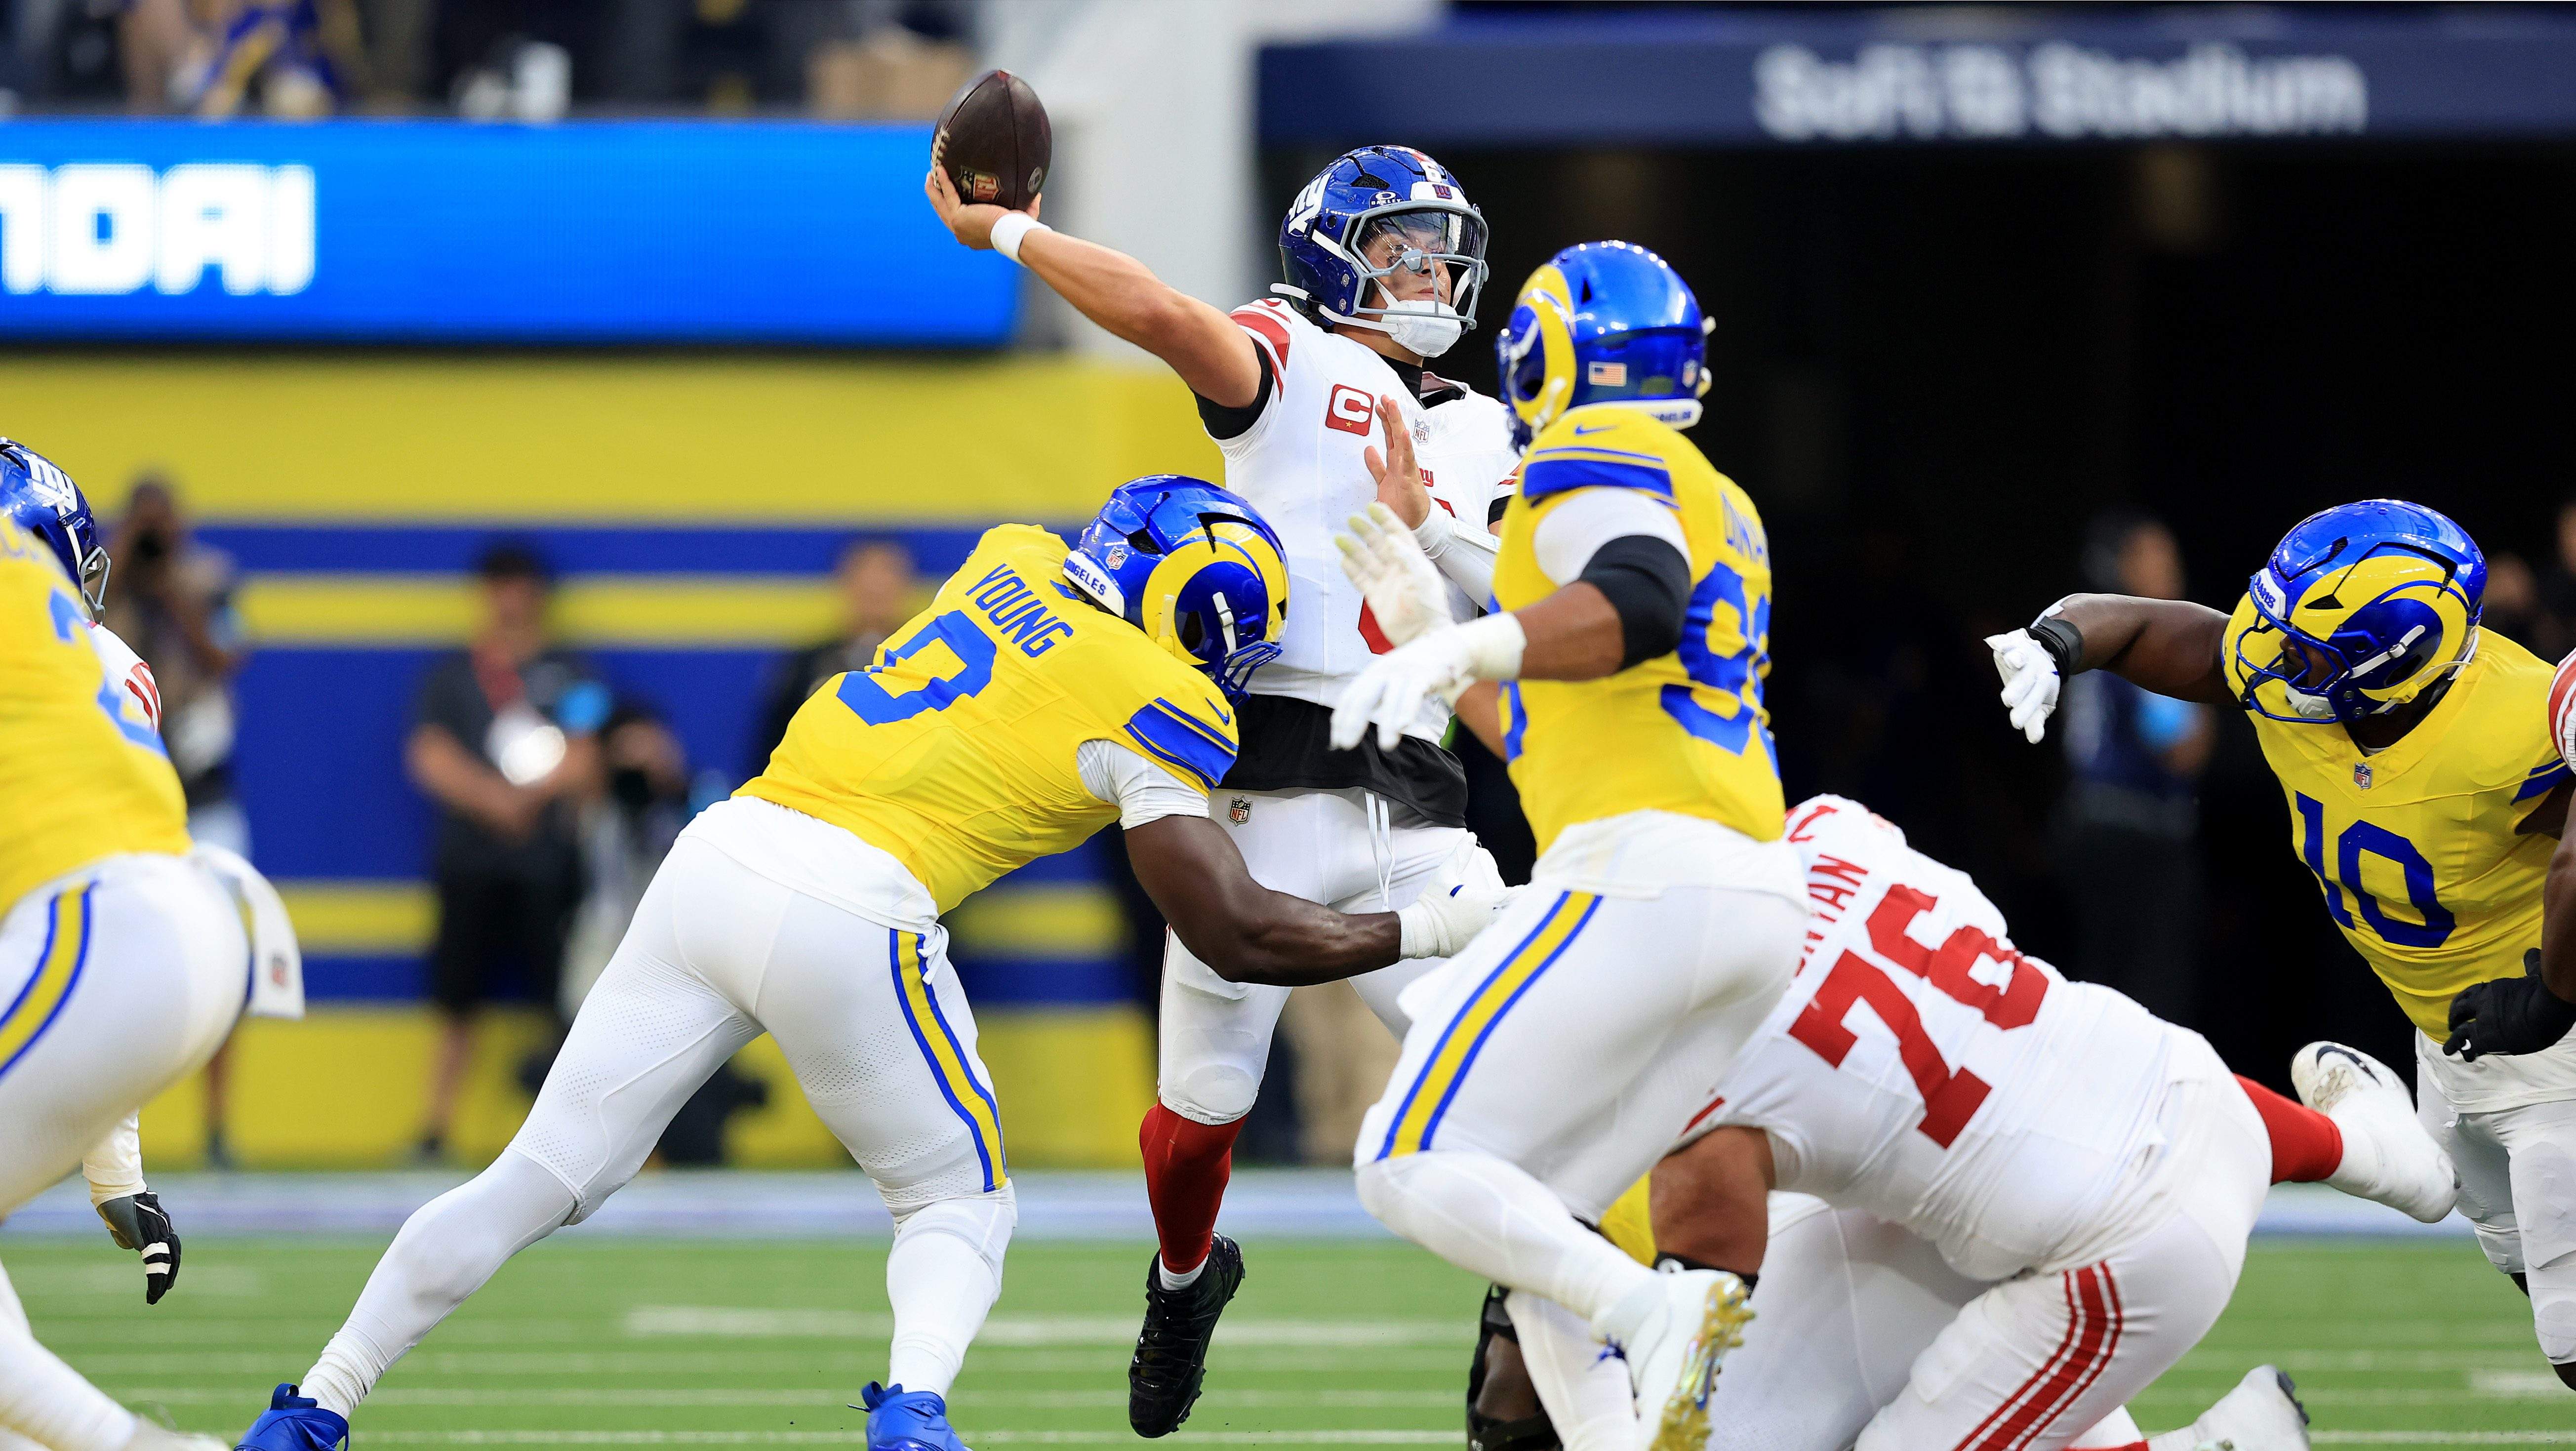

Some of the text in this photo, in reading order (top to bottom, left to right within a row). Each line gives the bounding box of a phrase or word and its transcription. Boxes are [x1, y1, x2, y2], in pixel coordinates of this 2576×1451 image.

[1332, 388, 1373, 424] C
[1415, 428, 1427, 441] NFL
[965, 563, 1074, 658] YOUNG
[836, 609, 997, 727] 0
[1231, 808, 1247, 821] NFL
[2295, 790, 2456, 948] 10
[1788, 883, 2049, 1150] 76
